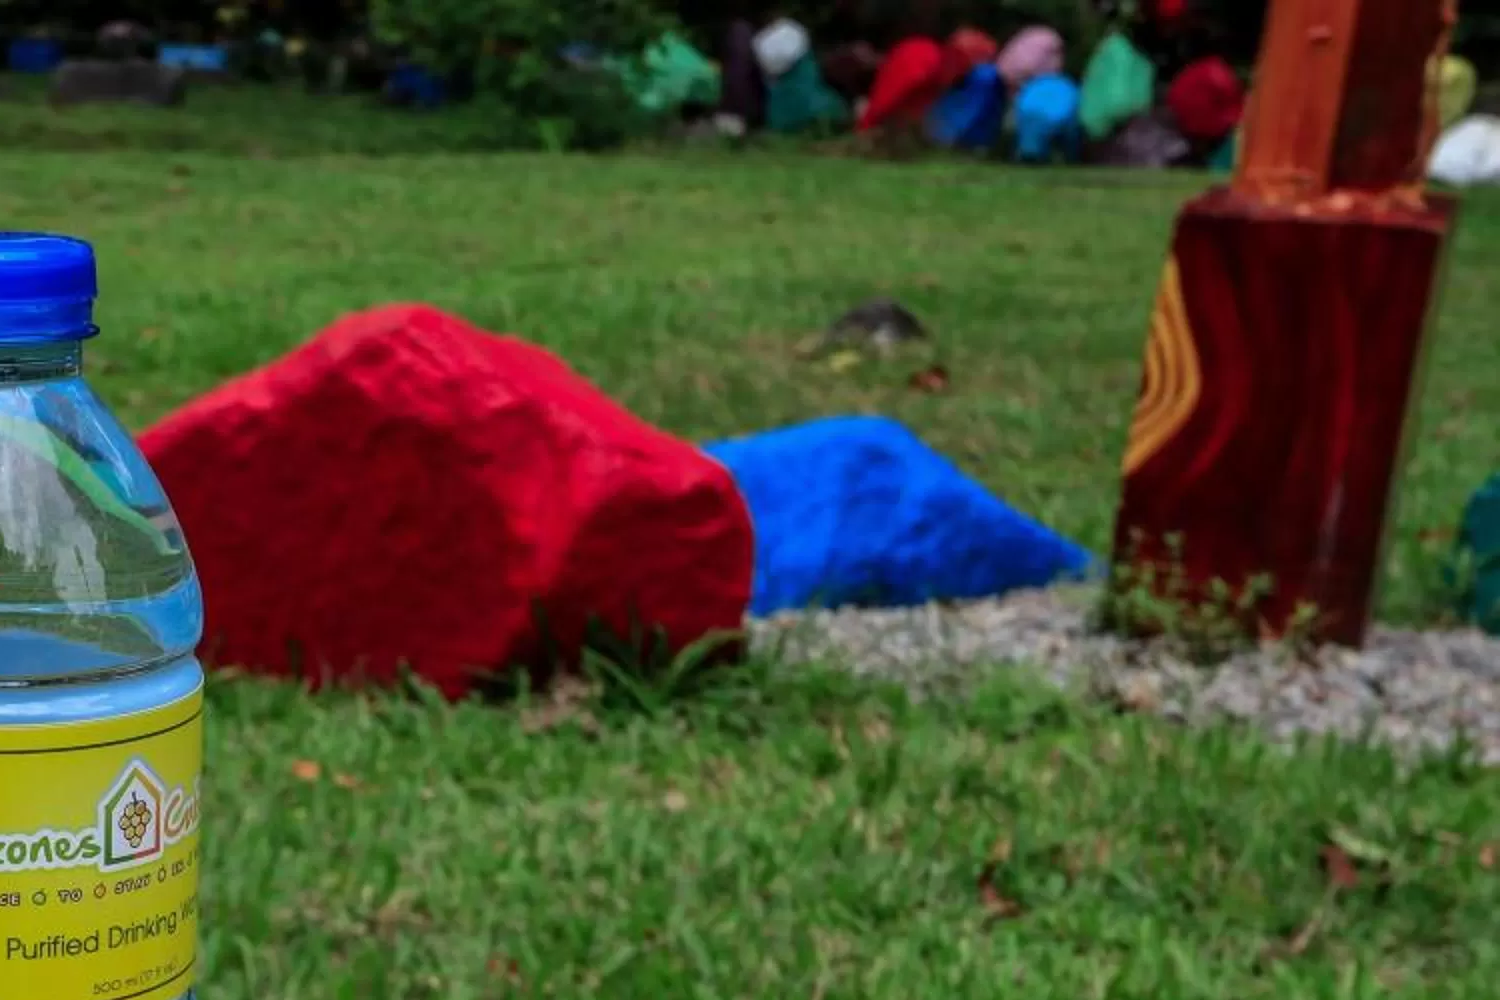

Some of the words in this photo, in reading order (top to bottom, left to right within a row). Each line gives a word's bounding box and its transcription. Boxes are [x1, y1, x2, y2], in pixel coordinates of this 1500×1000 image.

[58, 888, 83, 903] TO
[6, 930, 100, 961] Purified
[107, 911, 177, 949] Drinking
